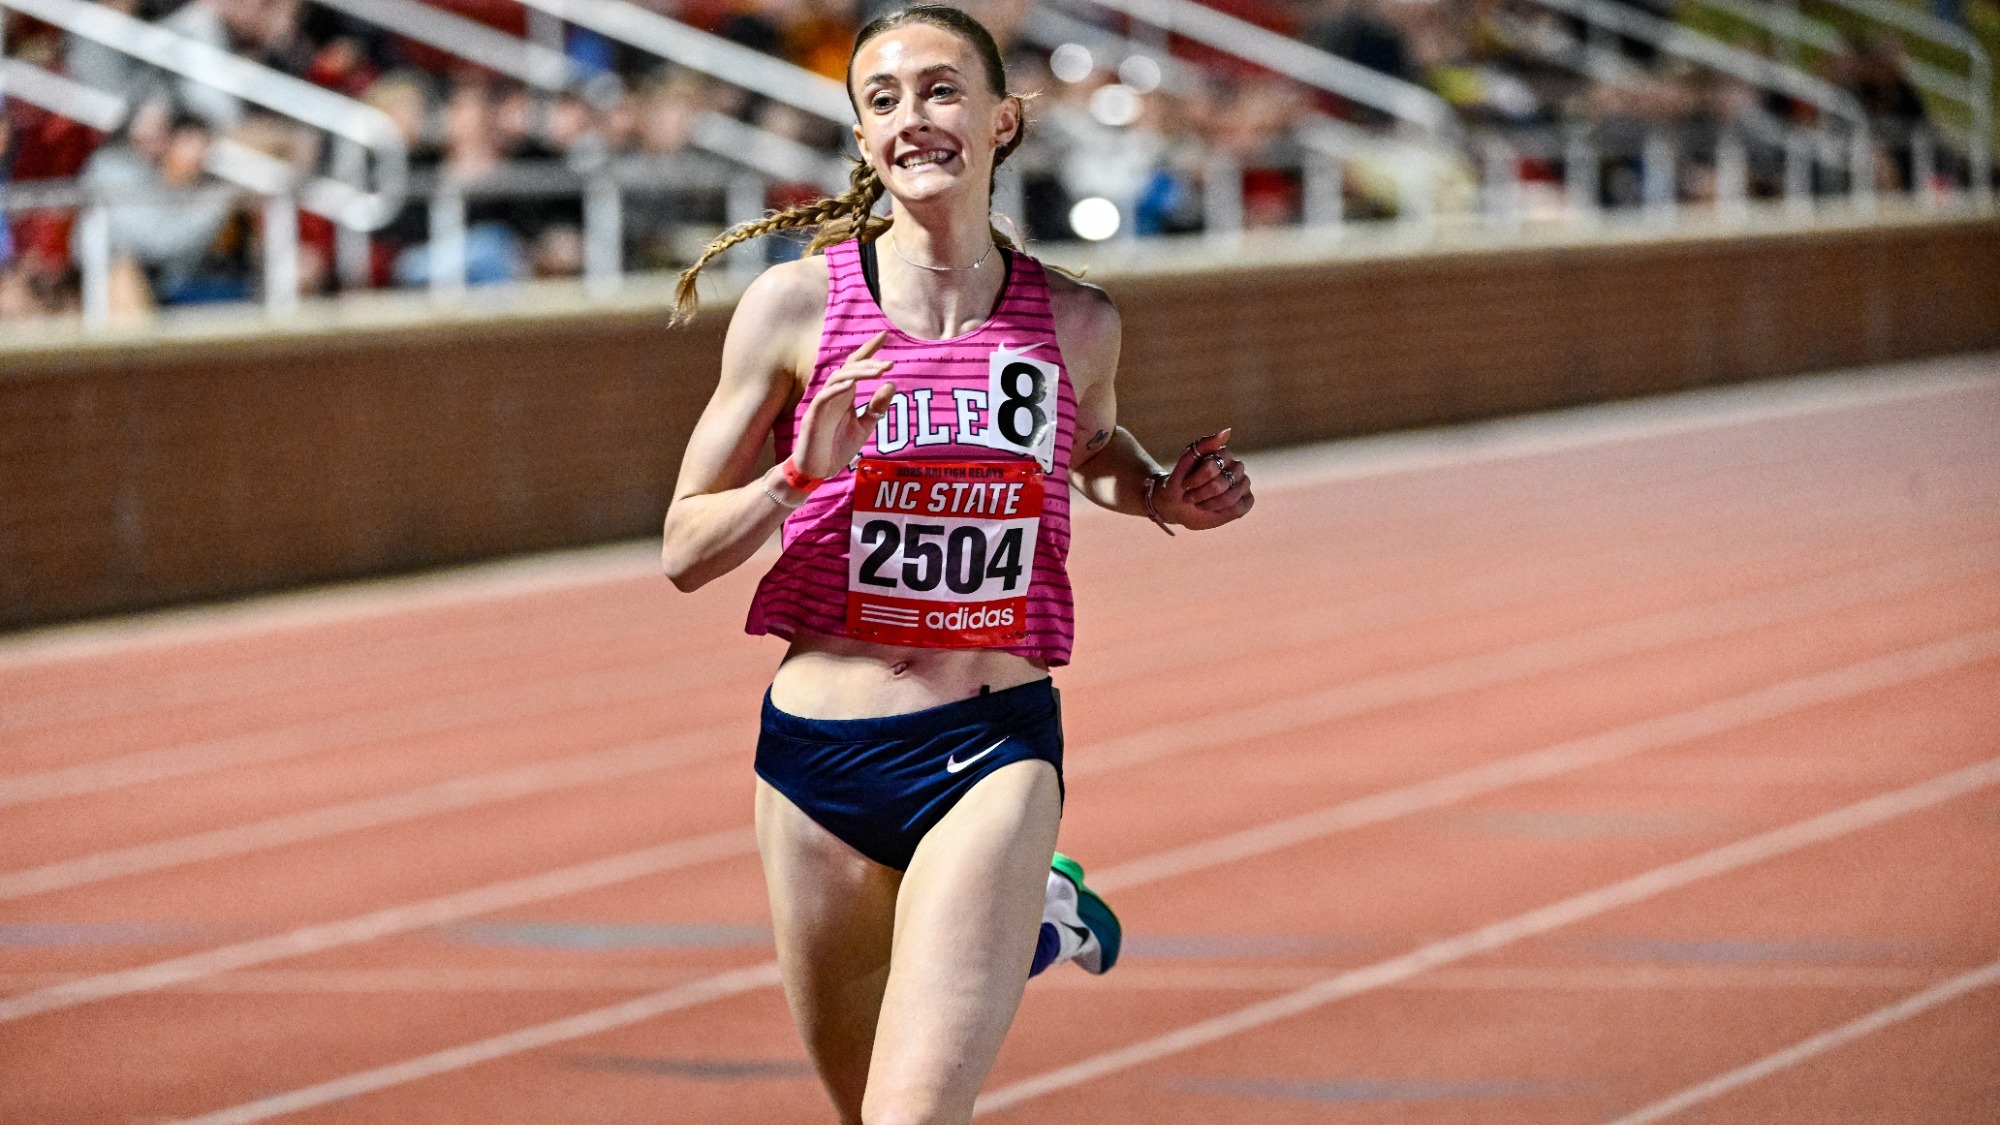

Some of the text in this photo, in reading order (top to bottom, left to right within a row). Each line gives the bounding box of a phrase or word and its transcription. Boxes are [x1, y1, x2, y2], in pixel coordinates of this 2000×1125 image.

[997, 361, 1048, 448] 8
[925, 467, 966, 478] RALEIGH
[969, 467, 1004, 478] RELAYS
[874, 480, 1025, 516] NC STATE
[858, 519, 1024, 595] 2504
[925, 605, 1015, 631] adidas
